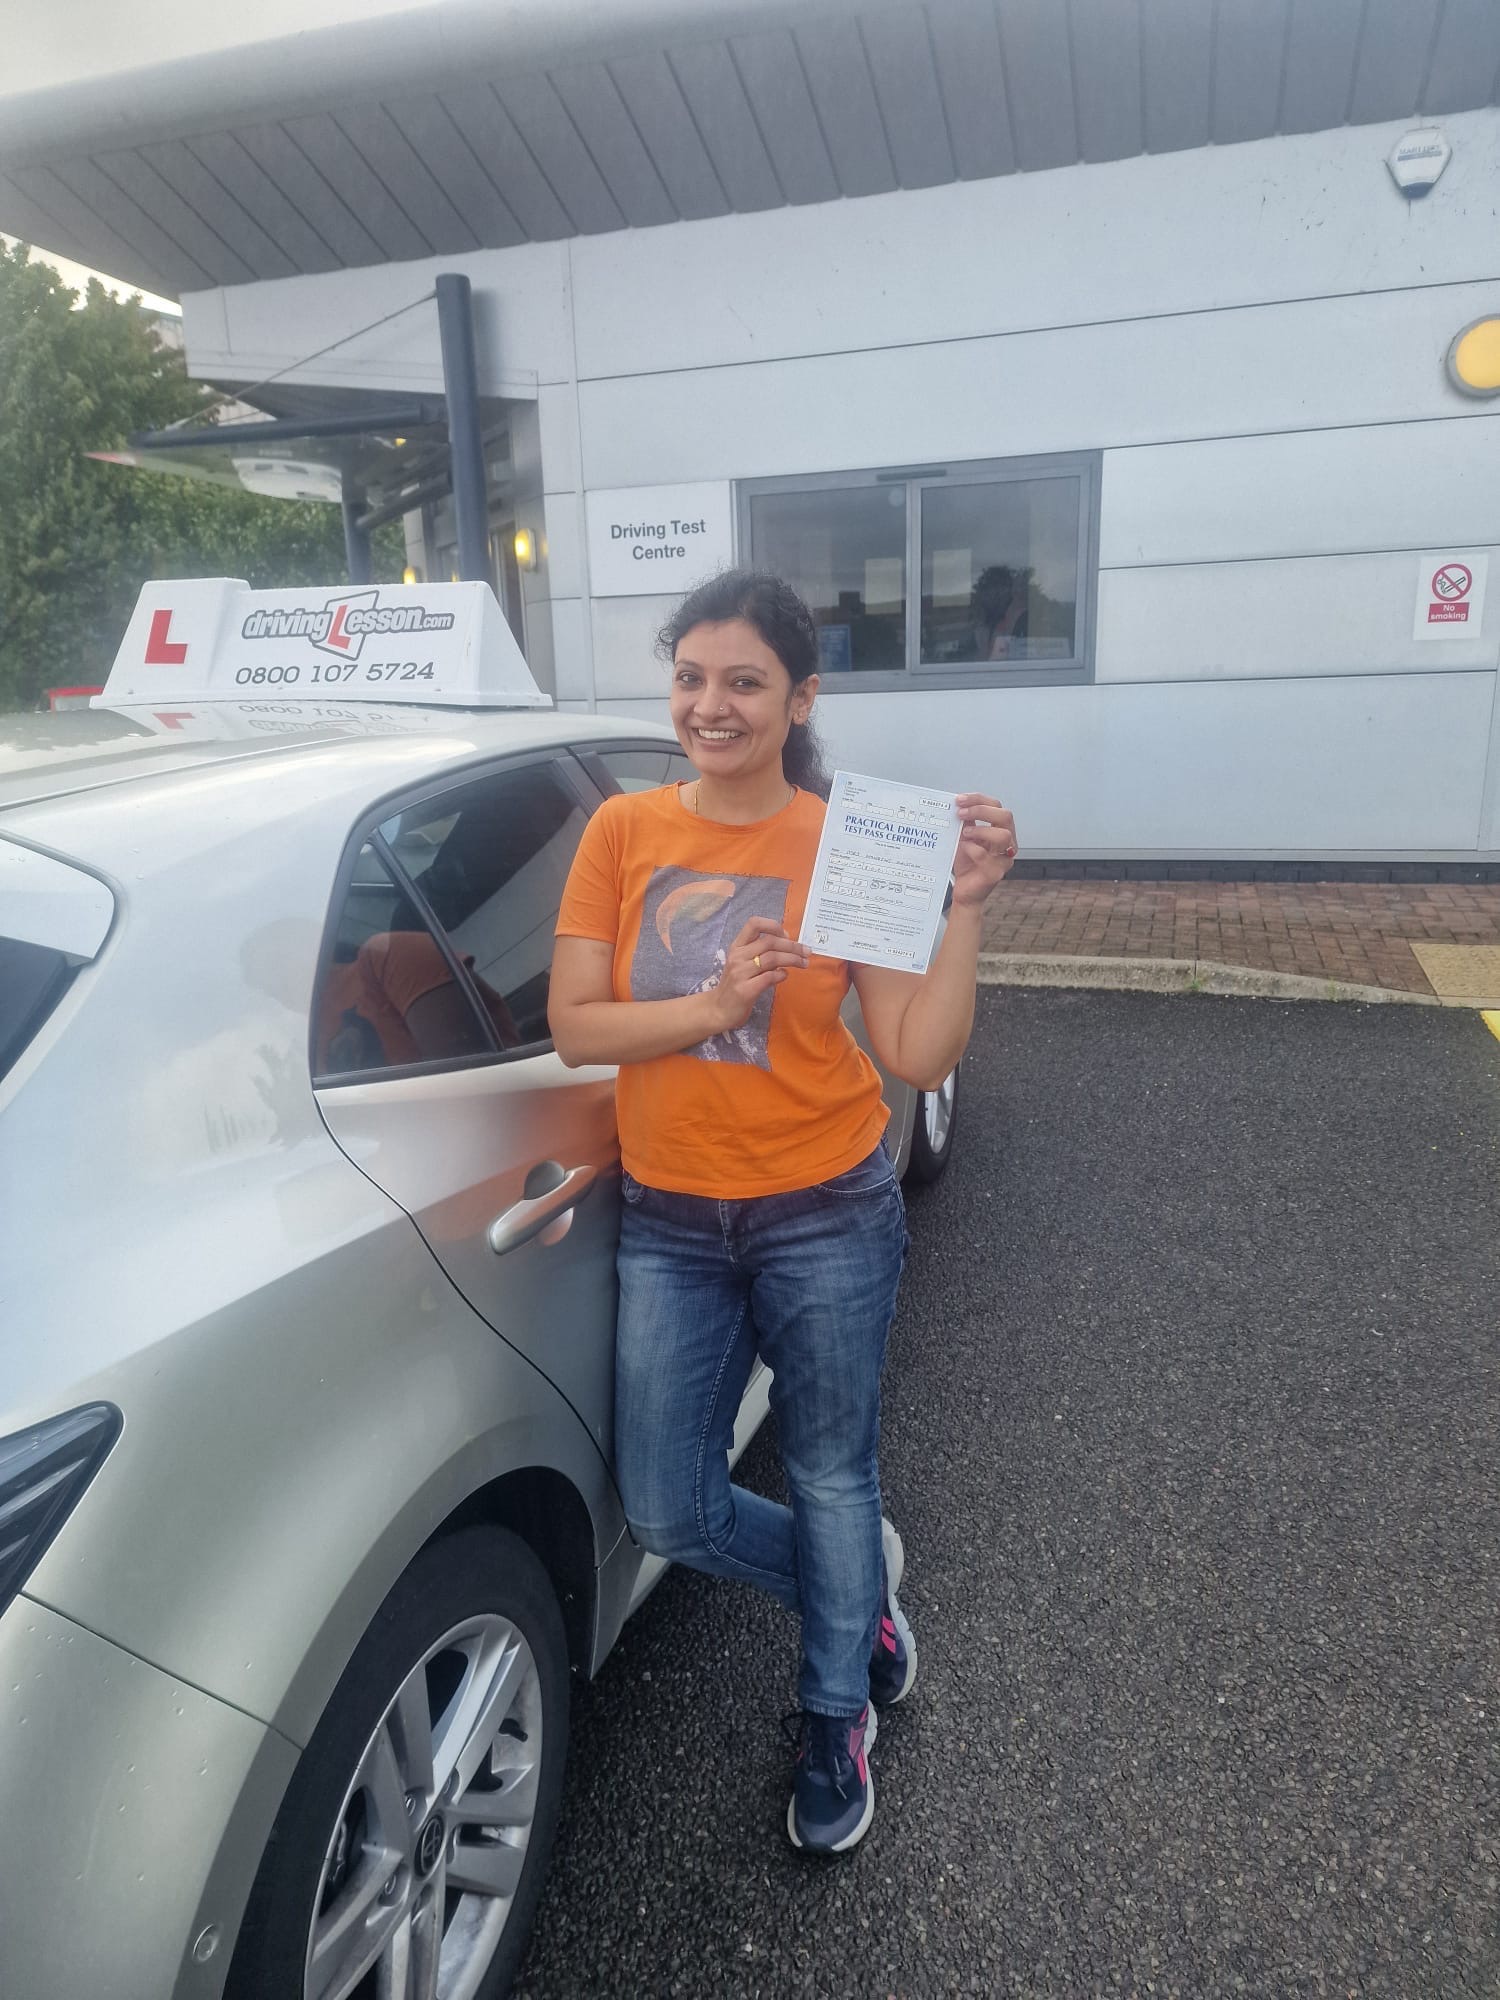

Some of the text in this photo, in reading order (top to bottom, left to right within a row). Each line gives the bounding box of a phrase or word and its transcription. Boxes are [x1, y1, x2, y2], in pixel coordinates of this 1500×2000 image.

[611, 519, 706, 540] Driving Test
[632, 545, 685, 560] Centre
[1430, 612, 1466, 620] smoking
[144, 609, 188, 664] L
[235, 662, 435, 685] 0800 107 5724
[844, 824, 863, 835] TEST
[864, 827, 884, 839] PASS
[886, 831, 937, 850] CERTIFICATE
[845, 815, 939, 841] PRACTICAL DRIVING
